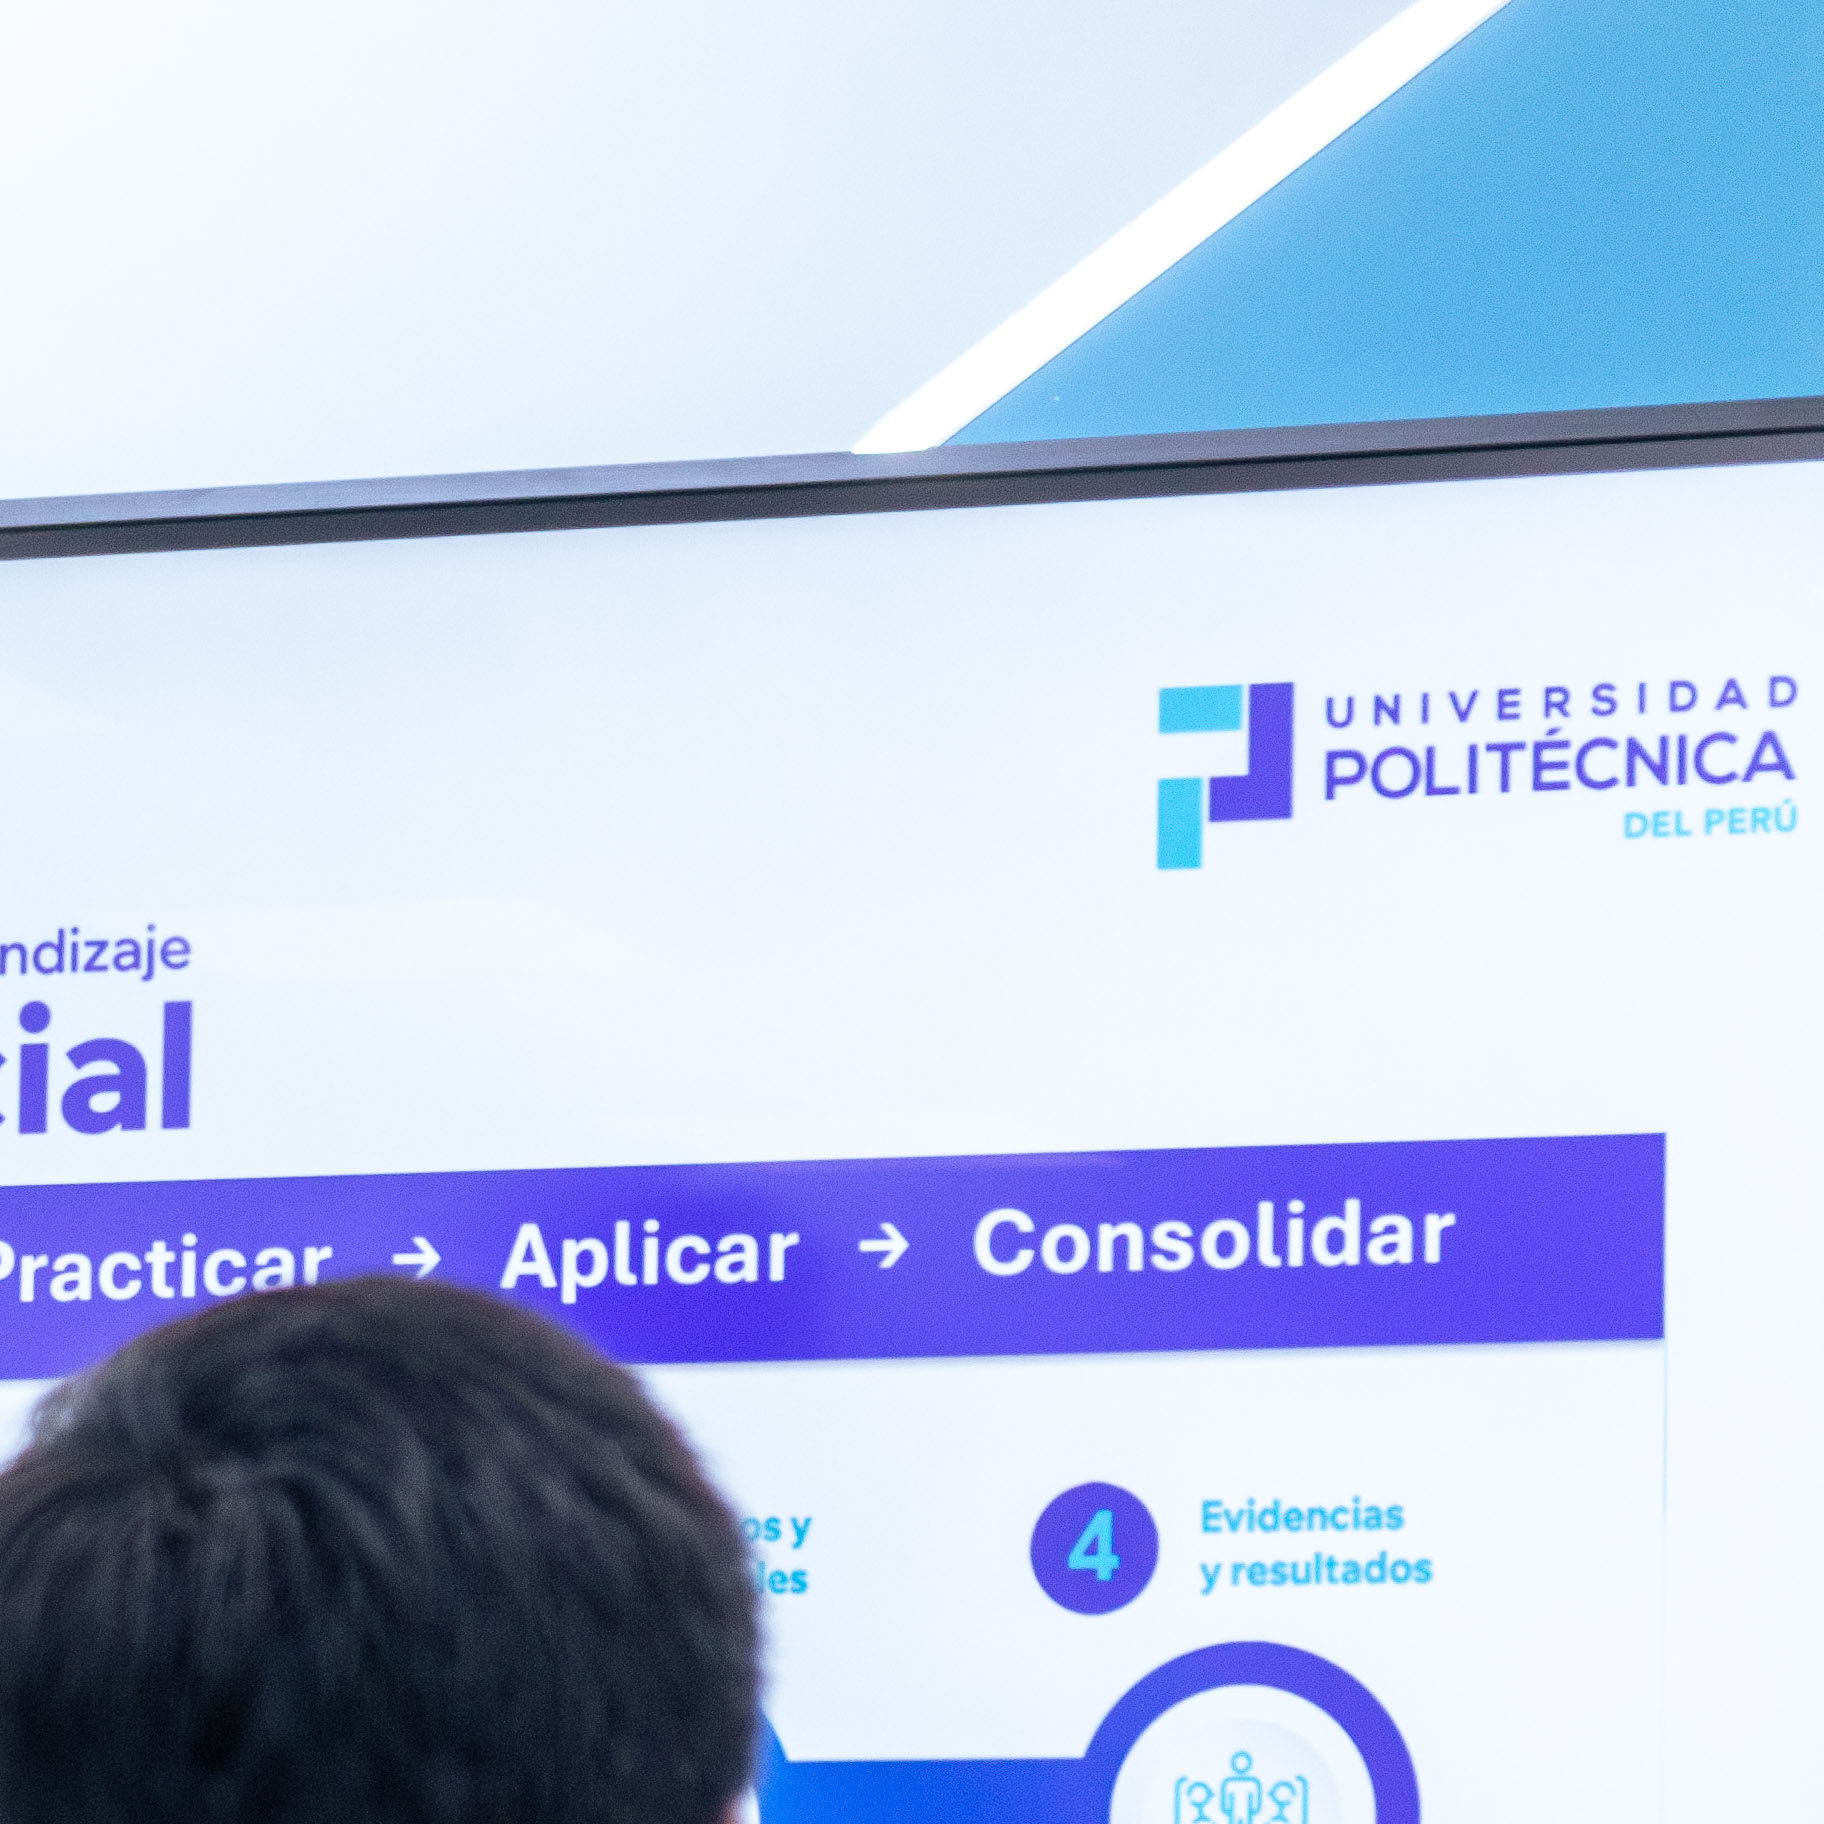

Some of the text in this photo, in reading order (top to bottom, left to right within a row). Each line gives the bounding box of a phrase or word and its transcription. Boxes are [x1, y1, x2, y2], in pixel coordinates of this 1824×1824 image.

[1324, 675, 1799, 730] UNIVERSIDAD
[1324, 728, 1797, 801] POLITÉCNICA
[1623, 798, 1798, 840] DEL PERÚ
[500, 1221, 800, 1304] Aplicar
[973, 1198, 1456, 1276] Consolidar
[789, 1516, 814, 1551] y
[1200, 1495, 1406, 1535] Evidencias
[1068, 1508, 1121, 1582] 4
[1199, 1549, 1434, 1597] y resultados
